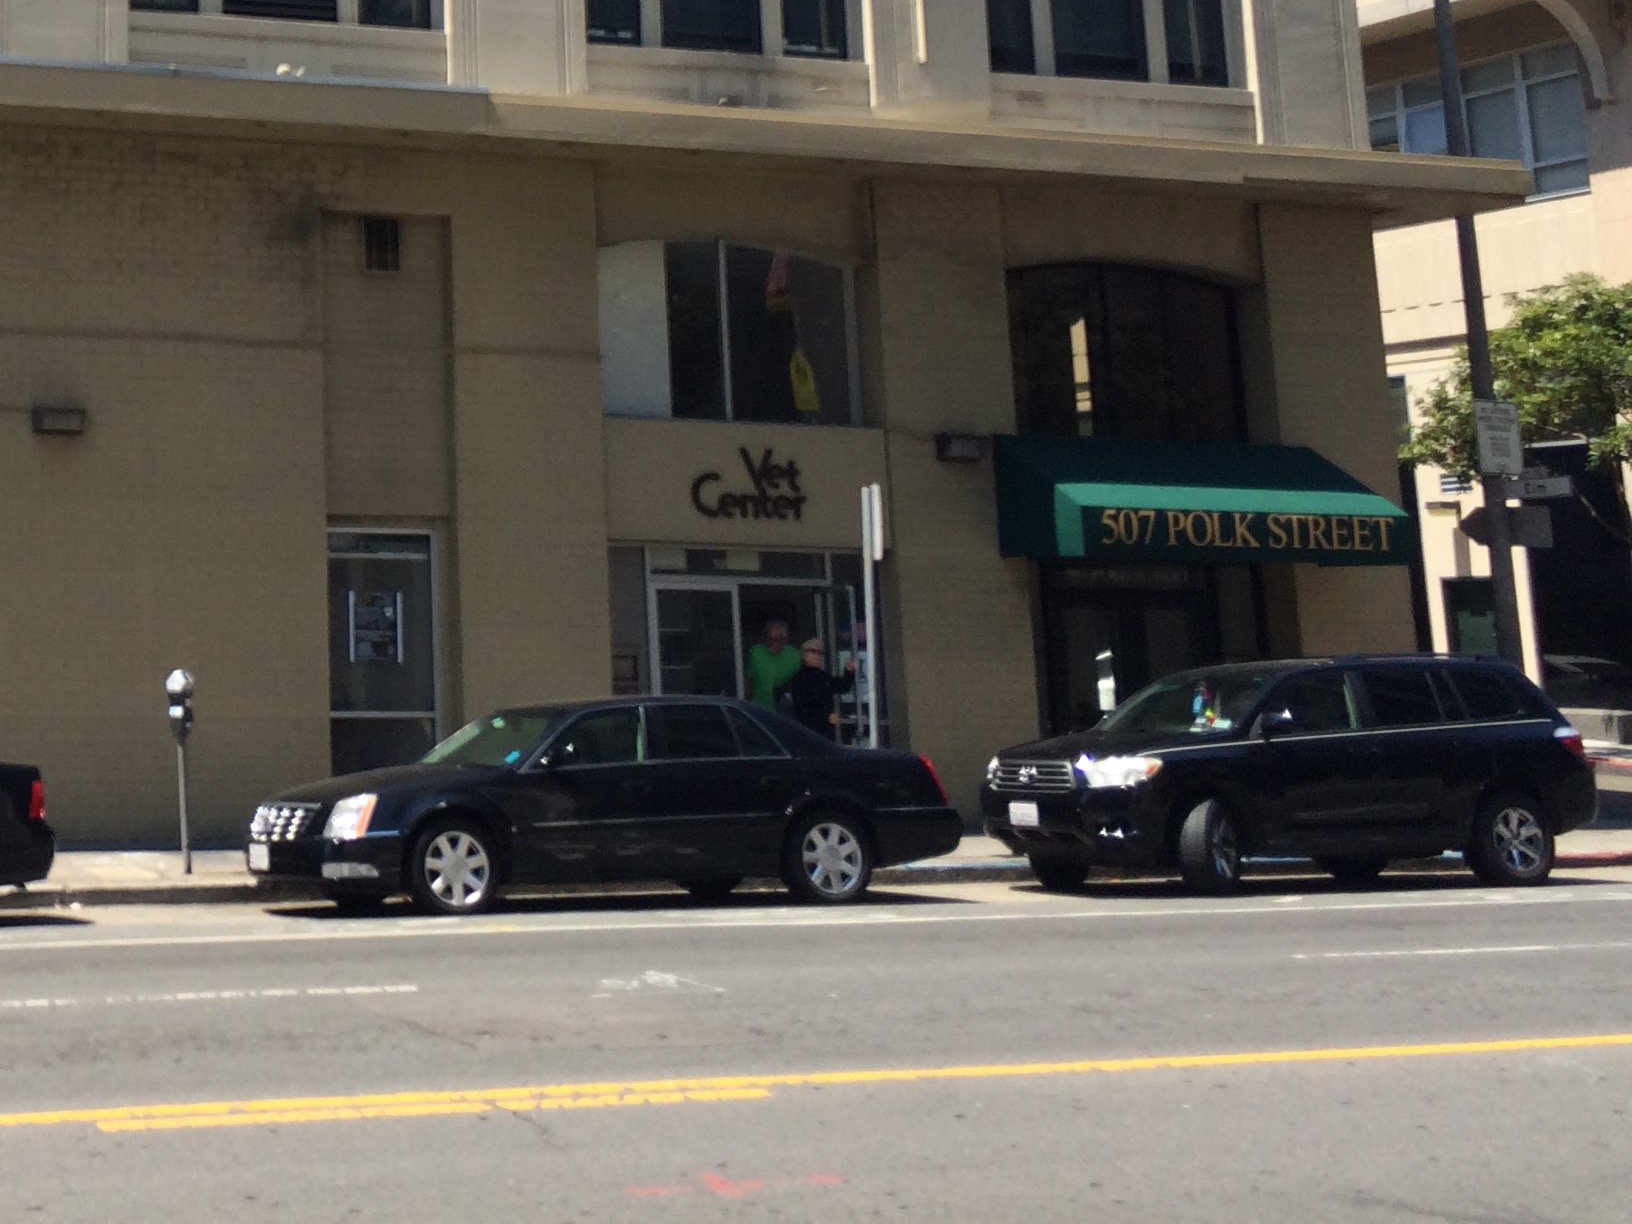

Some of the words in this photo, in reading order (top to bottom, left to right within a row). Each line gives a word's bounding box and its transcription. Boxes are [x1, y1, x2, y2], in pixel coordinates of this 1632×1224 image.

[737, 445, 802, 493] Vet
[690, 471, 808, 520] Center
[1100, 508, 1156, 544] 507
[1165, 511, 1261, 548] POLK
[1267, 514, 1395, 551] STREET
